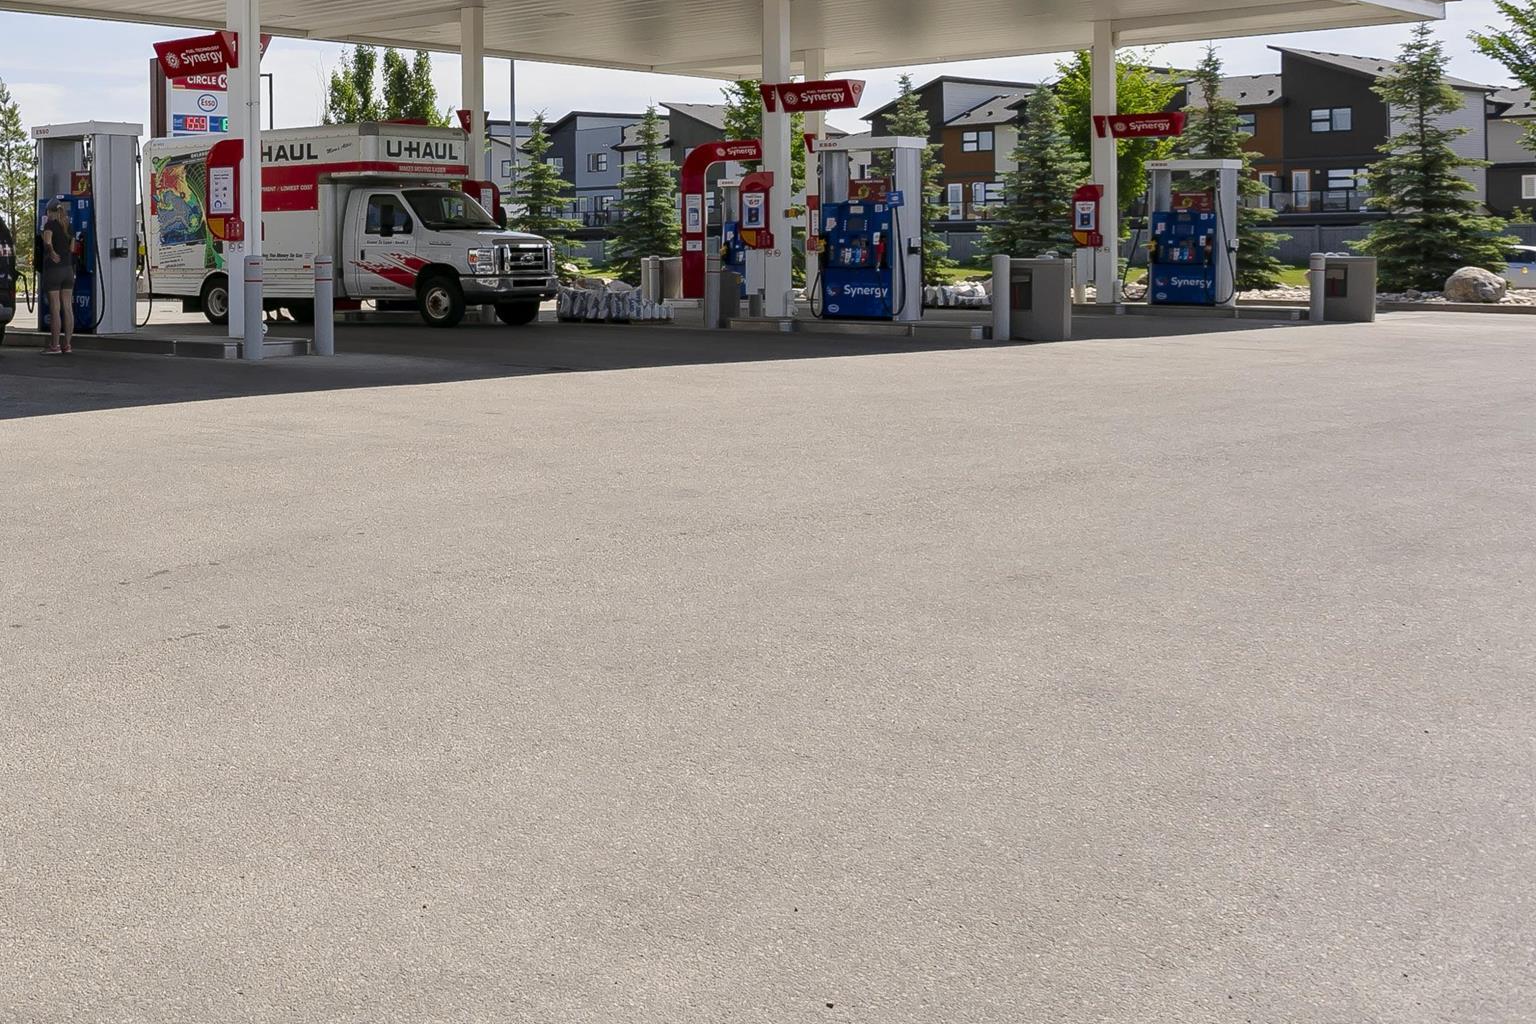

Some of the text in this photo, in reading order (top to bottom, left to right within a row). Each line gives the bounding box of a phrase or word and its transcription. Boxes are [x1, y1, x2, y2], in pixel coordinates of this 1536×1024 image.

[231, 39, 237, 53] 1
[180, 50, 224, 68] Synergy
[186, 75, 217, 86] CIRCLE
[800, 91, 845, 105] Synergy
[1128, 121, 1170, 132] Synergy
[726, 147, 757, 156] Synergy
[1170, 276, 1213, 289] Synergy
[843, 284, 888, 298] Synergy
